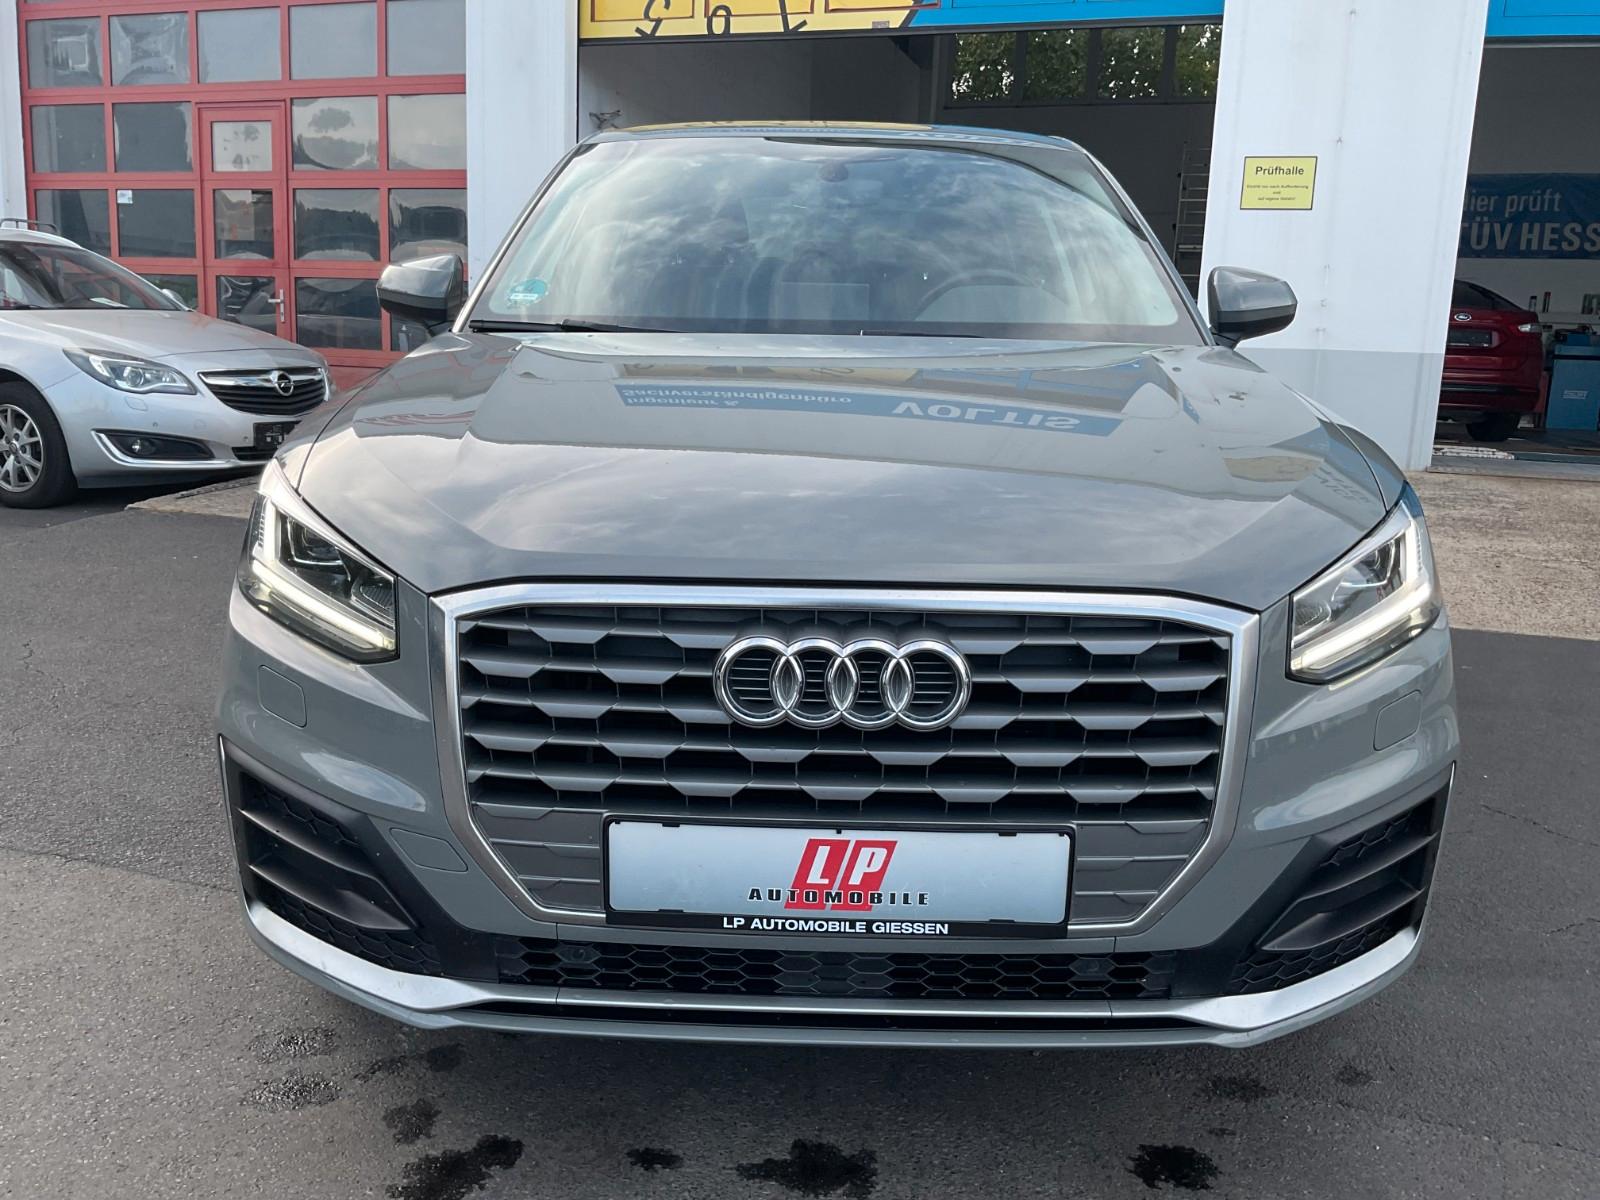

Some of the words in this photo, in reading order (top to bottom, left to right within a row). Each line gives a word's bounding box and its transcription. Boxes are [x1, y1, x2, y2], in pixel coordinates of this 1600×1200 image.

[1255, 166, 1304, 175] Prüfhalle
[1505, 188, 1562, 218] prüft
[1520, 222, 1600, 252] HESS
[806, 845, 888, 885] LP
[748, 888, 930, 905] AUTOMOBILE
[723, 917, 745, 928] LP
[750, 918, 867, 933] AUTOMOBILE
[872, 921, 949, 935] GIESSEN
